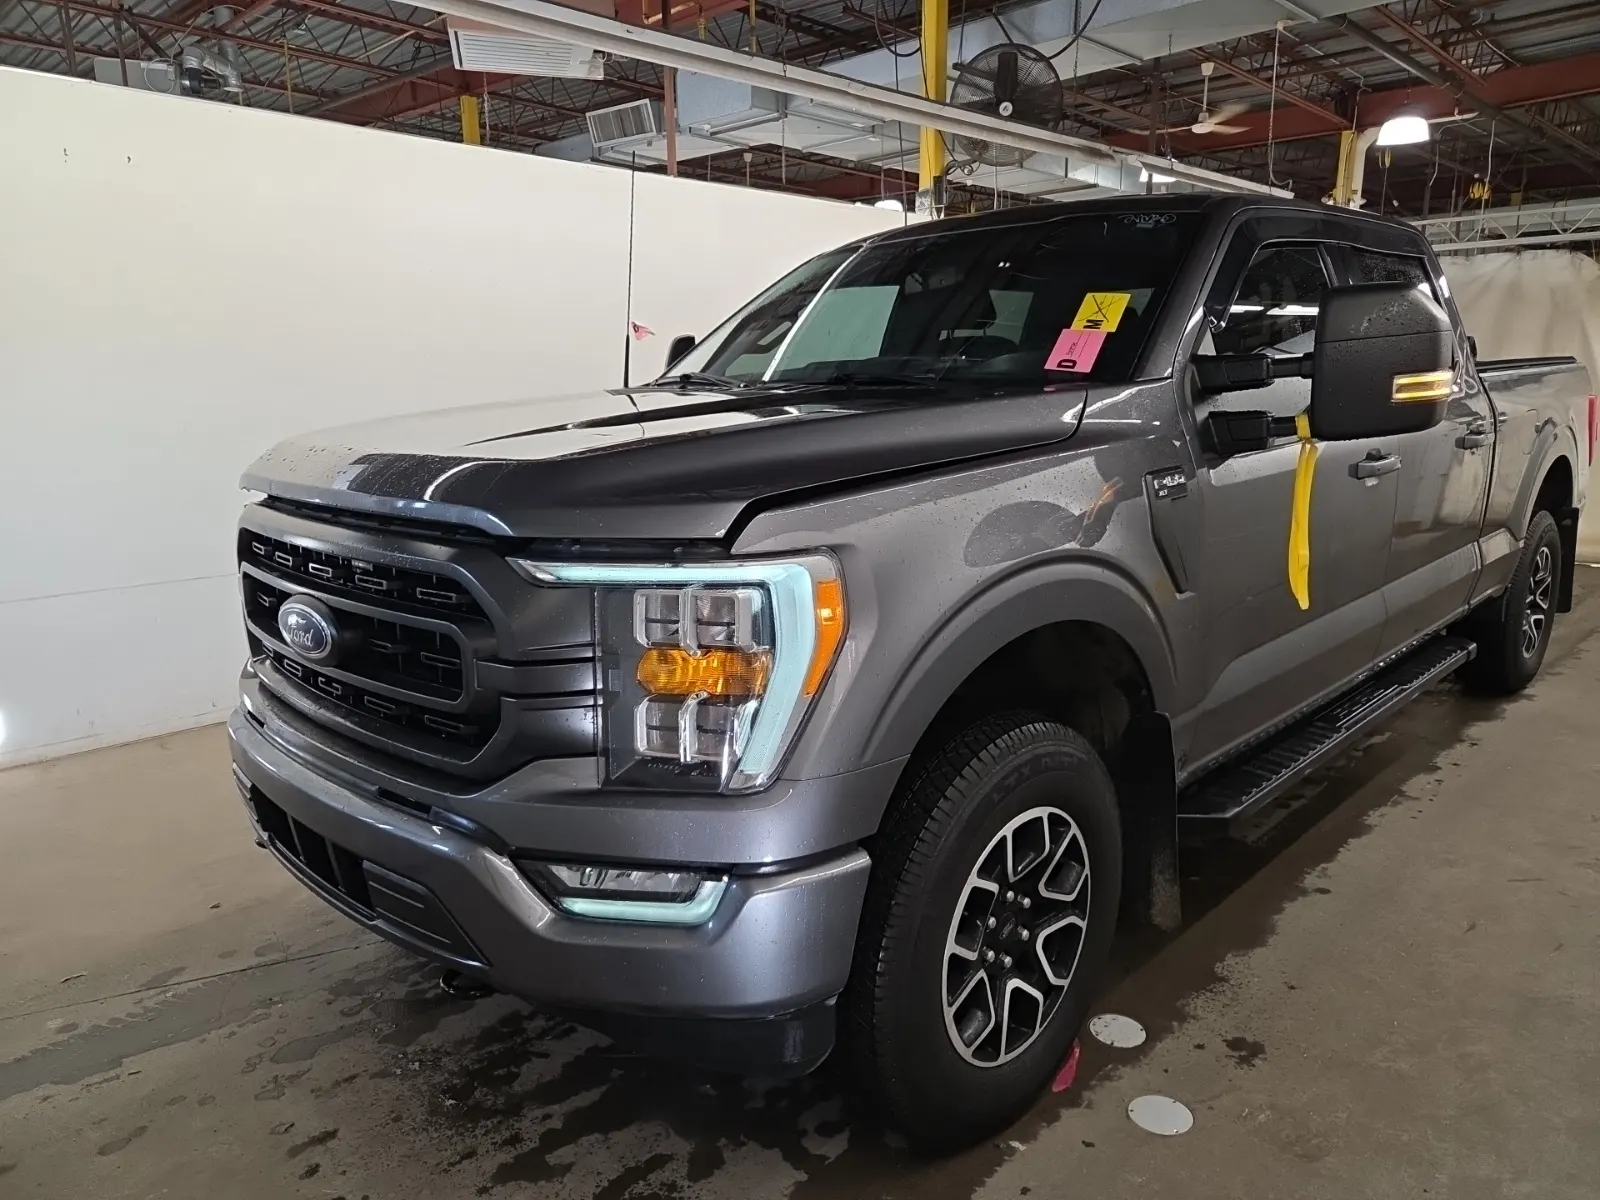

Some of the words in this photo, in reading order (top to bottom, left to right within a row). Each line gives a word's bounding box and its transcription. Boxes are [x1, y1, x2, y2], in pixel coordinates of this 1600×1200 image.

[1083, 319, 1104, 329] M
[1056, 359, 1077, 369] D
[287, 614, 313, 647] Ford
